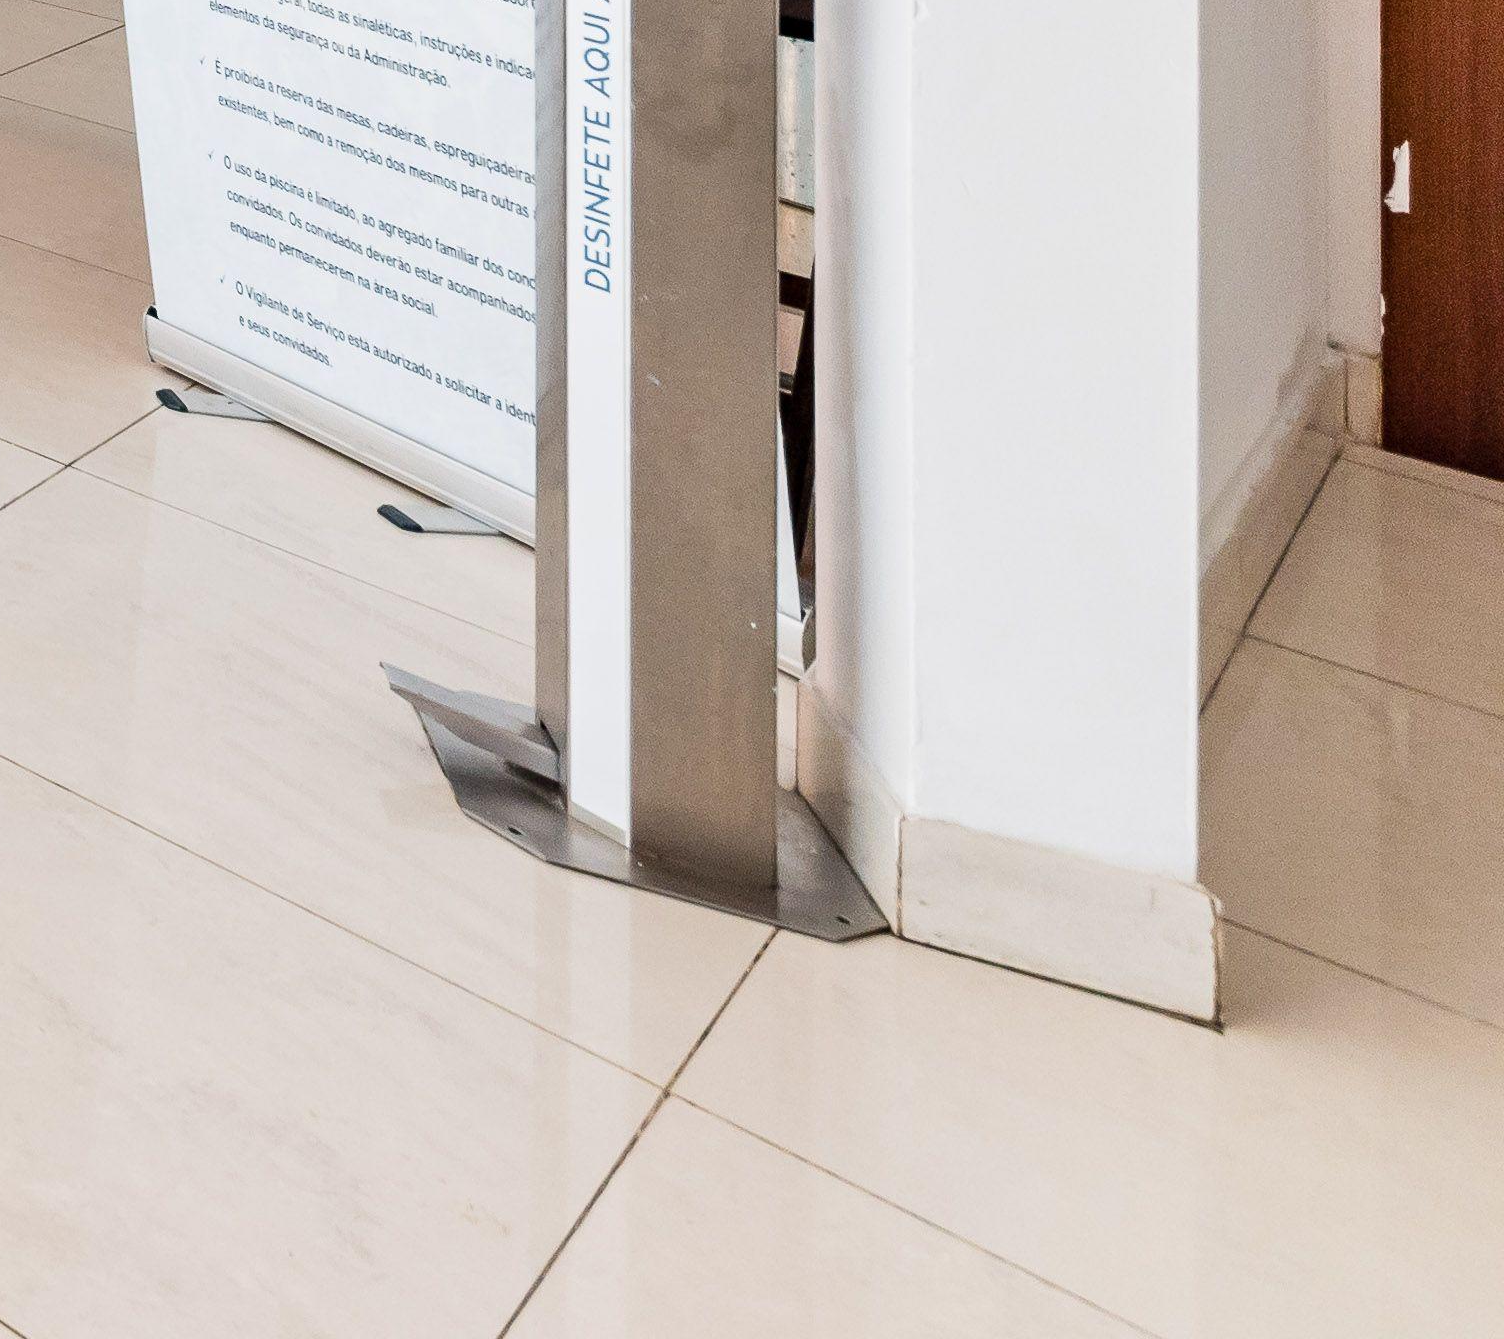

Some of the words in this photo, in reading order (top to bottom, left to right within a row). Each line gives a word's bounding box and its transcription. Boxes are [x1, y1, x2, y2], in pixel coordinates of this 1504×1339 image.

[262, 16, 276, 31] da
[276, 22, 330, 51] segurança
[331, 41, 345, 55] ou
[347, 44, 361, 60] da
[363, 48, 451, 88] Administração.
[582, 11, 612, 95] AQUI
[226, 190, 287, 222] convidados.
[288, 211, 303, 229] Os
[304, 221, 364, 255] convidados
[365, 245, 412, 274] deverão
[414, 266, 444, 286] estar
[582, 107, 613, 293] DESINFETE
[229, 221, 277, 249] enquanto
[278, 241, 356, 283] permanecerem
[357, 275, 371, 290] na
[401, 293, 438, 317] social.
[246, 319, 271, 338] seus
[272, 331, 333, 367] convidados.
